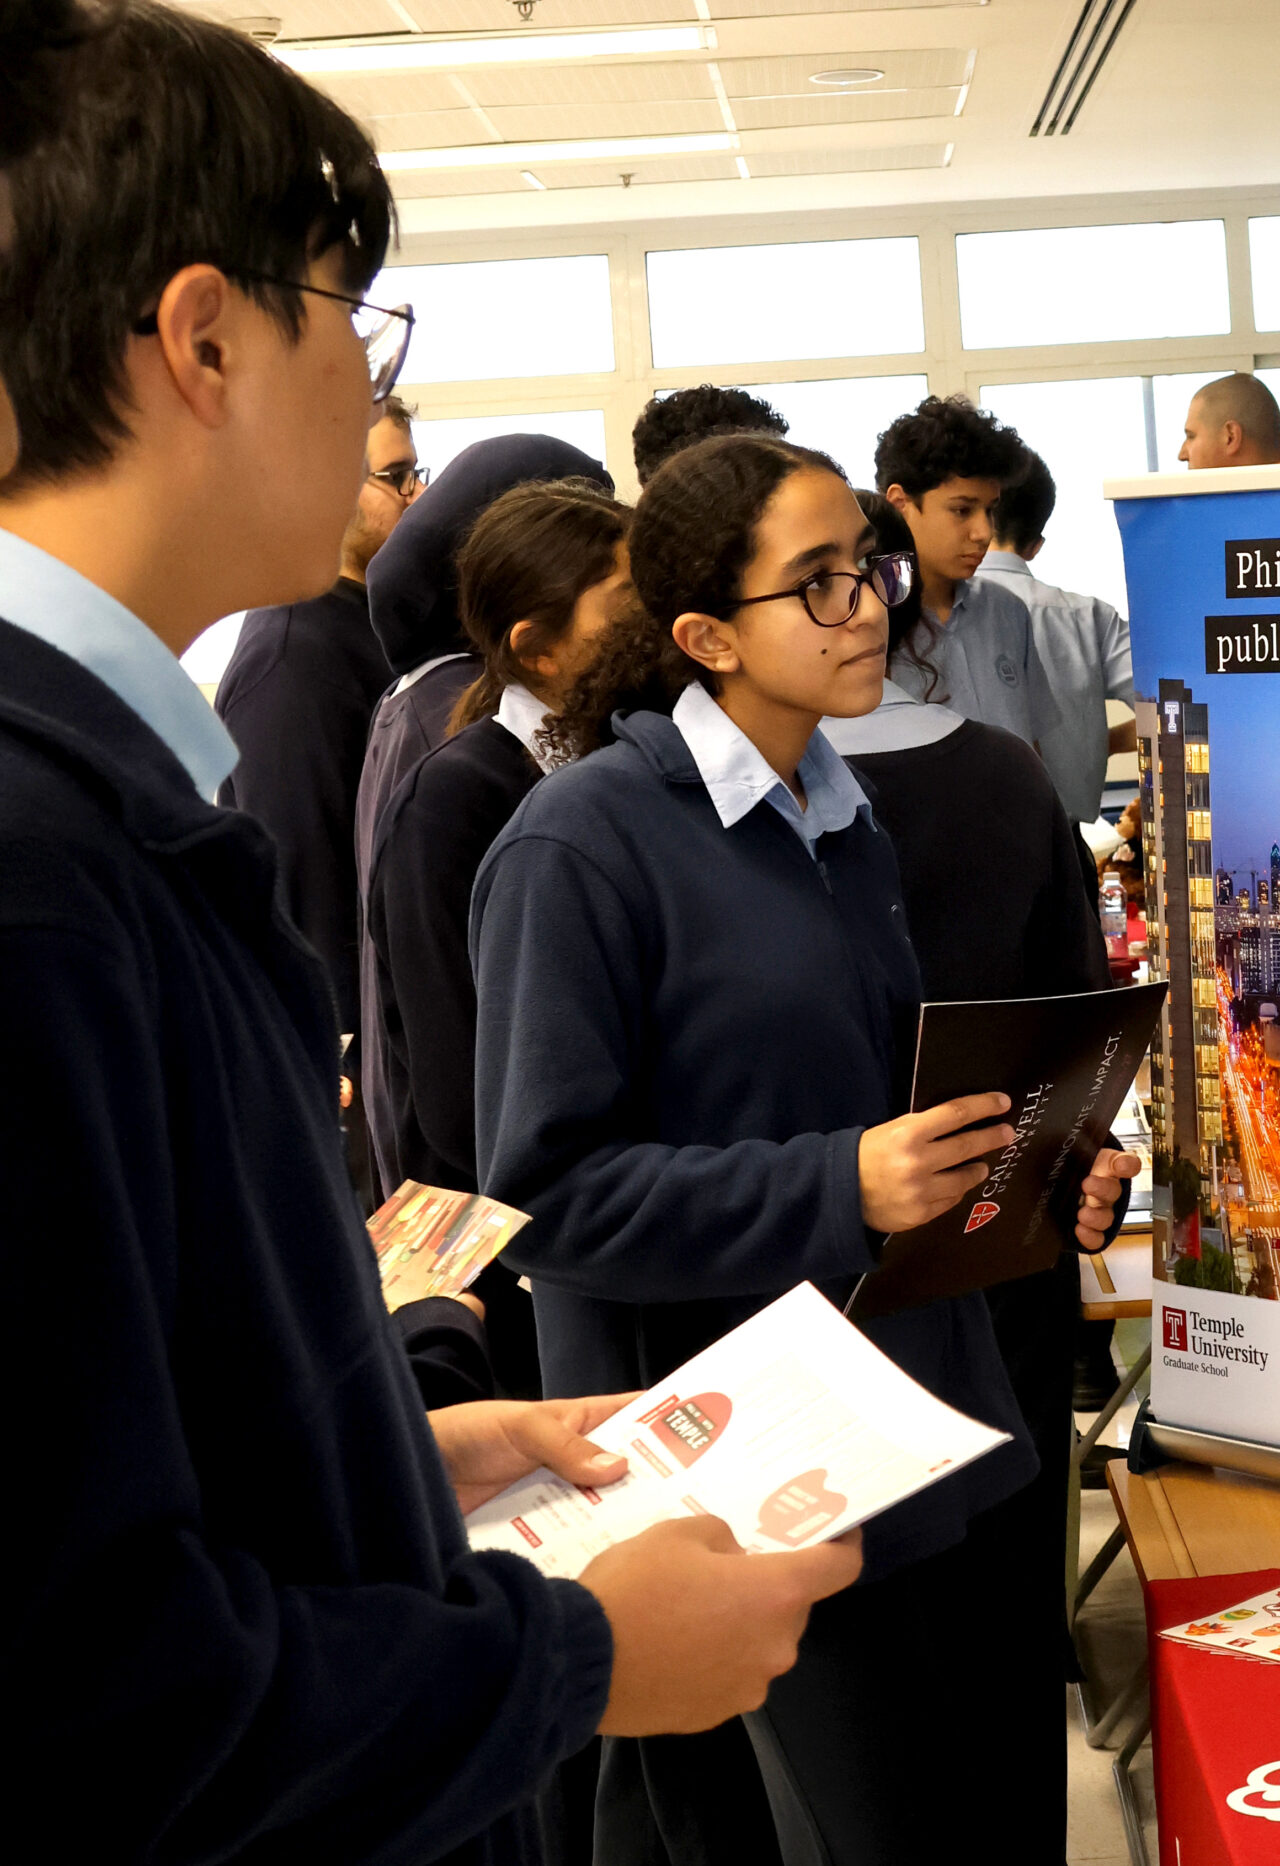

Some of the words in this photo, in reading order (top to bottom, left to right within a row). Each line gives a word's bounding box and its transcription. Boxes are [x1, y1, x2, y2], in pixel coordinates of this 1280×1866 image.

[1050, 1102, 1094, 1185] INNOVATE.
[1089, 1030, 1123, 1096] IMPACT.
[982, 1084, 1044, 1198] CALDWELL
[998, 1082, 1054, 1193] UNIVERSITY
[1190, 1311, 1244, 1340] Temple
[1163, 1356, 1199, 1373] Graduate
[1201, 1361, 1228, 1378] School
[1191, 1335, 1269, 1372] University
[666, 1409, 709, 1449] TEMPLE
